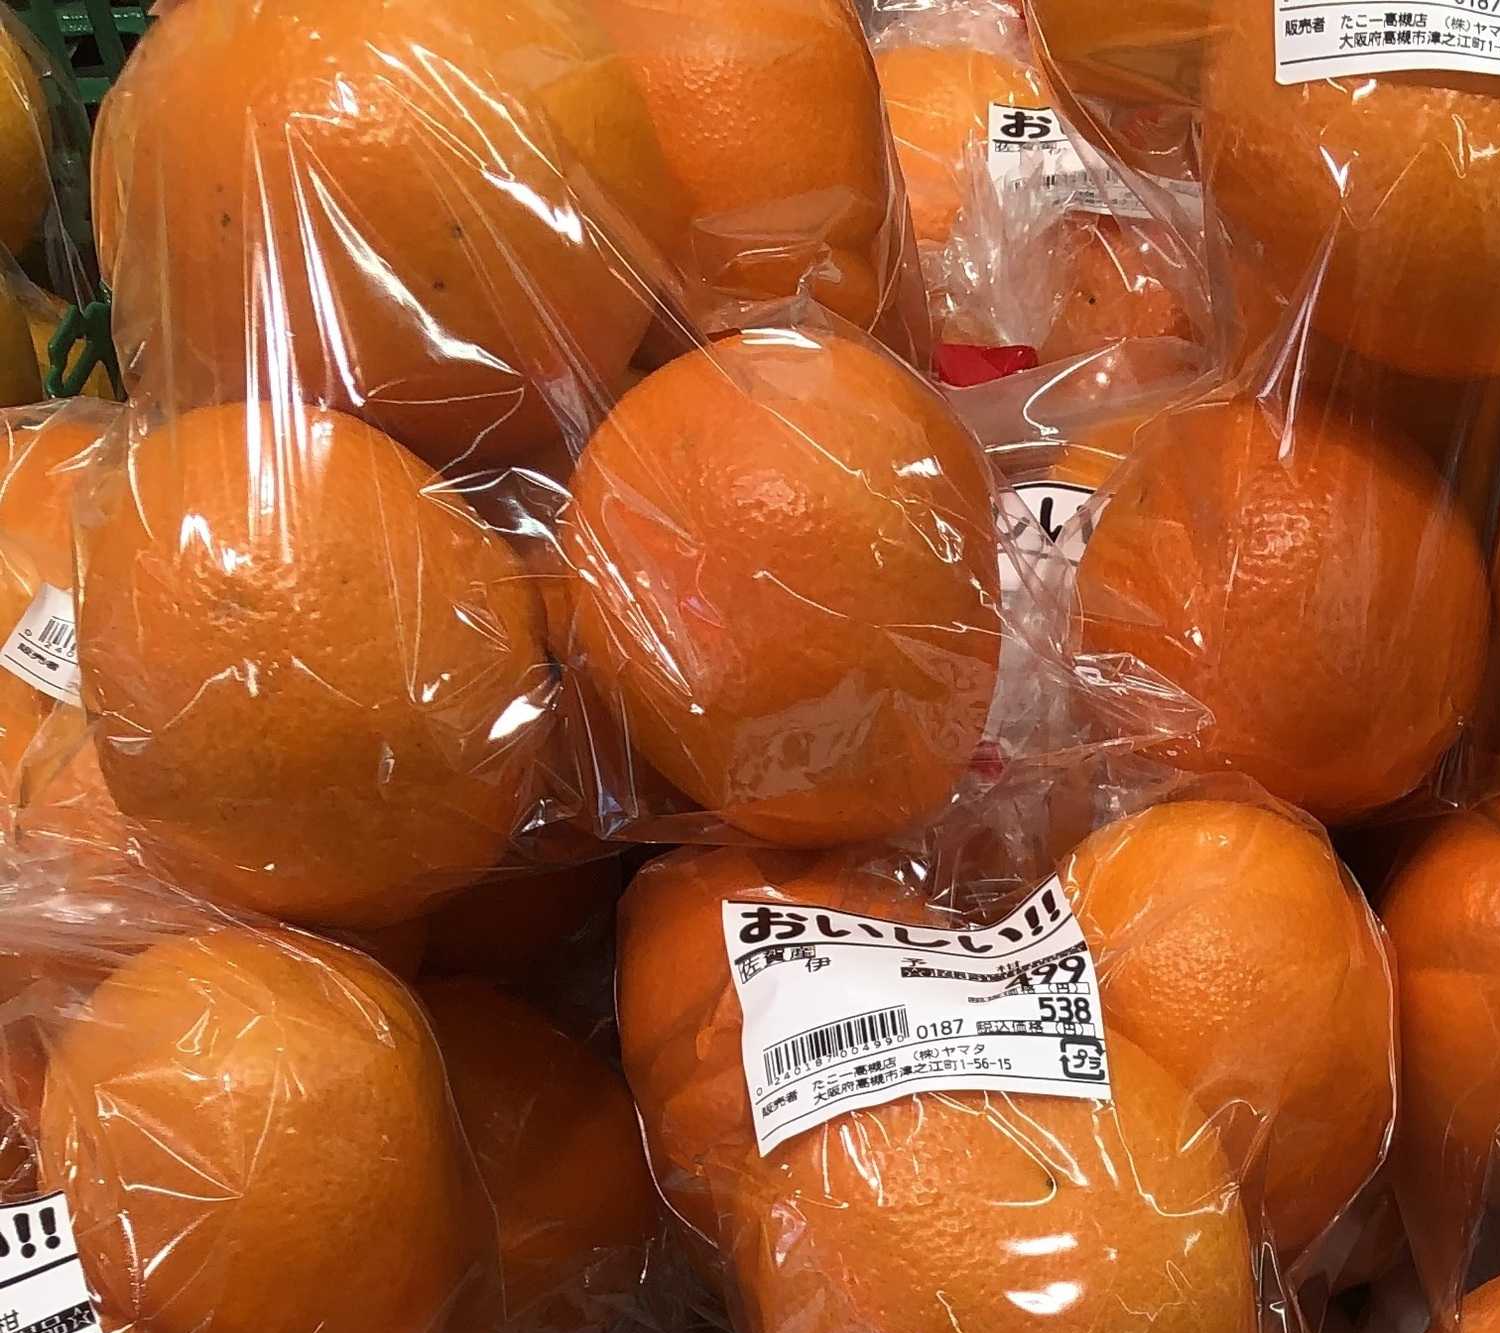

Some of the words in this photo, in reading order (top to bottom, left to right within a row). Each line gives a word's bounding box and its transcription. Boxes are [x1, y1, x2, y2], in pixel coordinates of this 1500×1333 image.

[1285, 19, 1325, 37] 販売者
[739, 888, 1060, 954] おいしい!!
[737, 945, 815, 984] 佐賀産
[1005, 955, 1086, 991] 499
[1039, 997, 1091, 1023] 538
[917, 1019, 963, 1039] 0187
[976, 1021, 1043, 1035] 税込価格
[1073, 1049, 1101, 1070] プラ
[762, 1089, 798, 1118] 販売者
